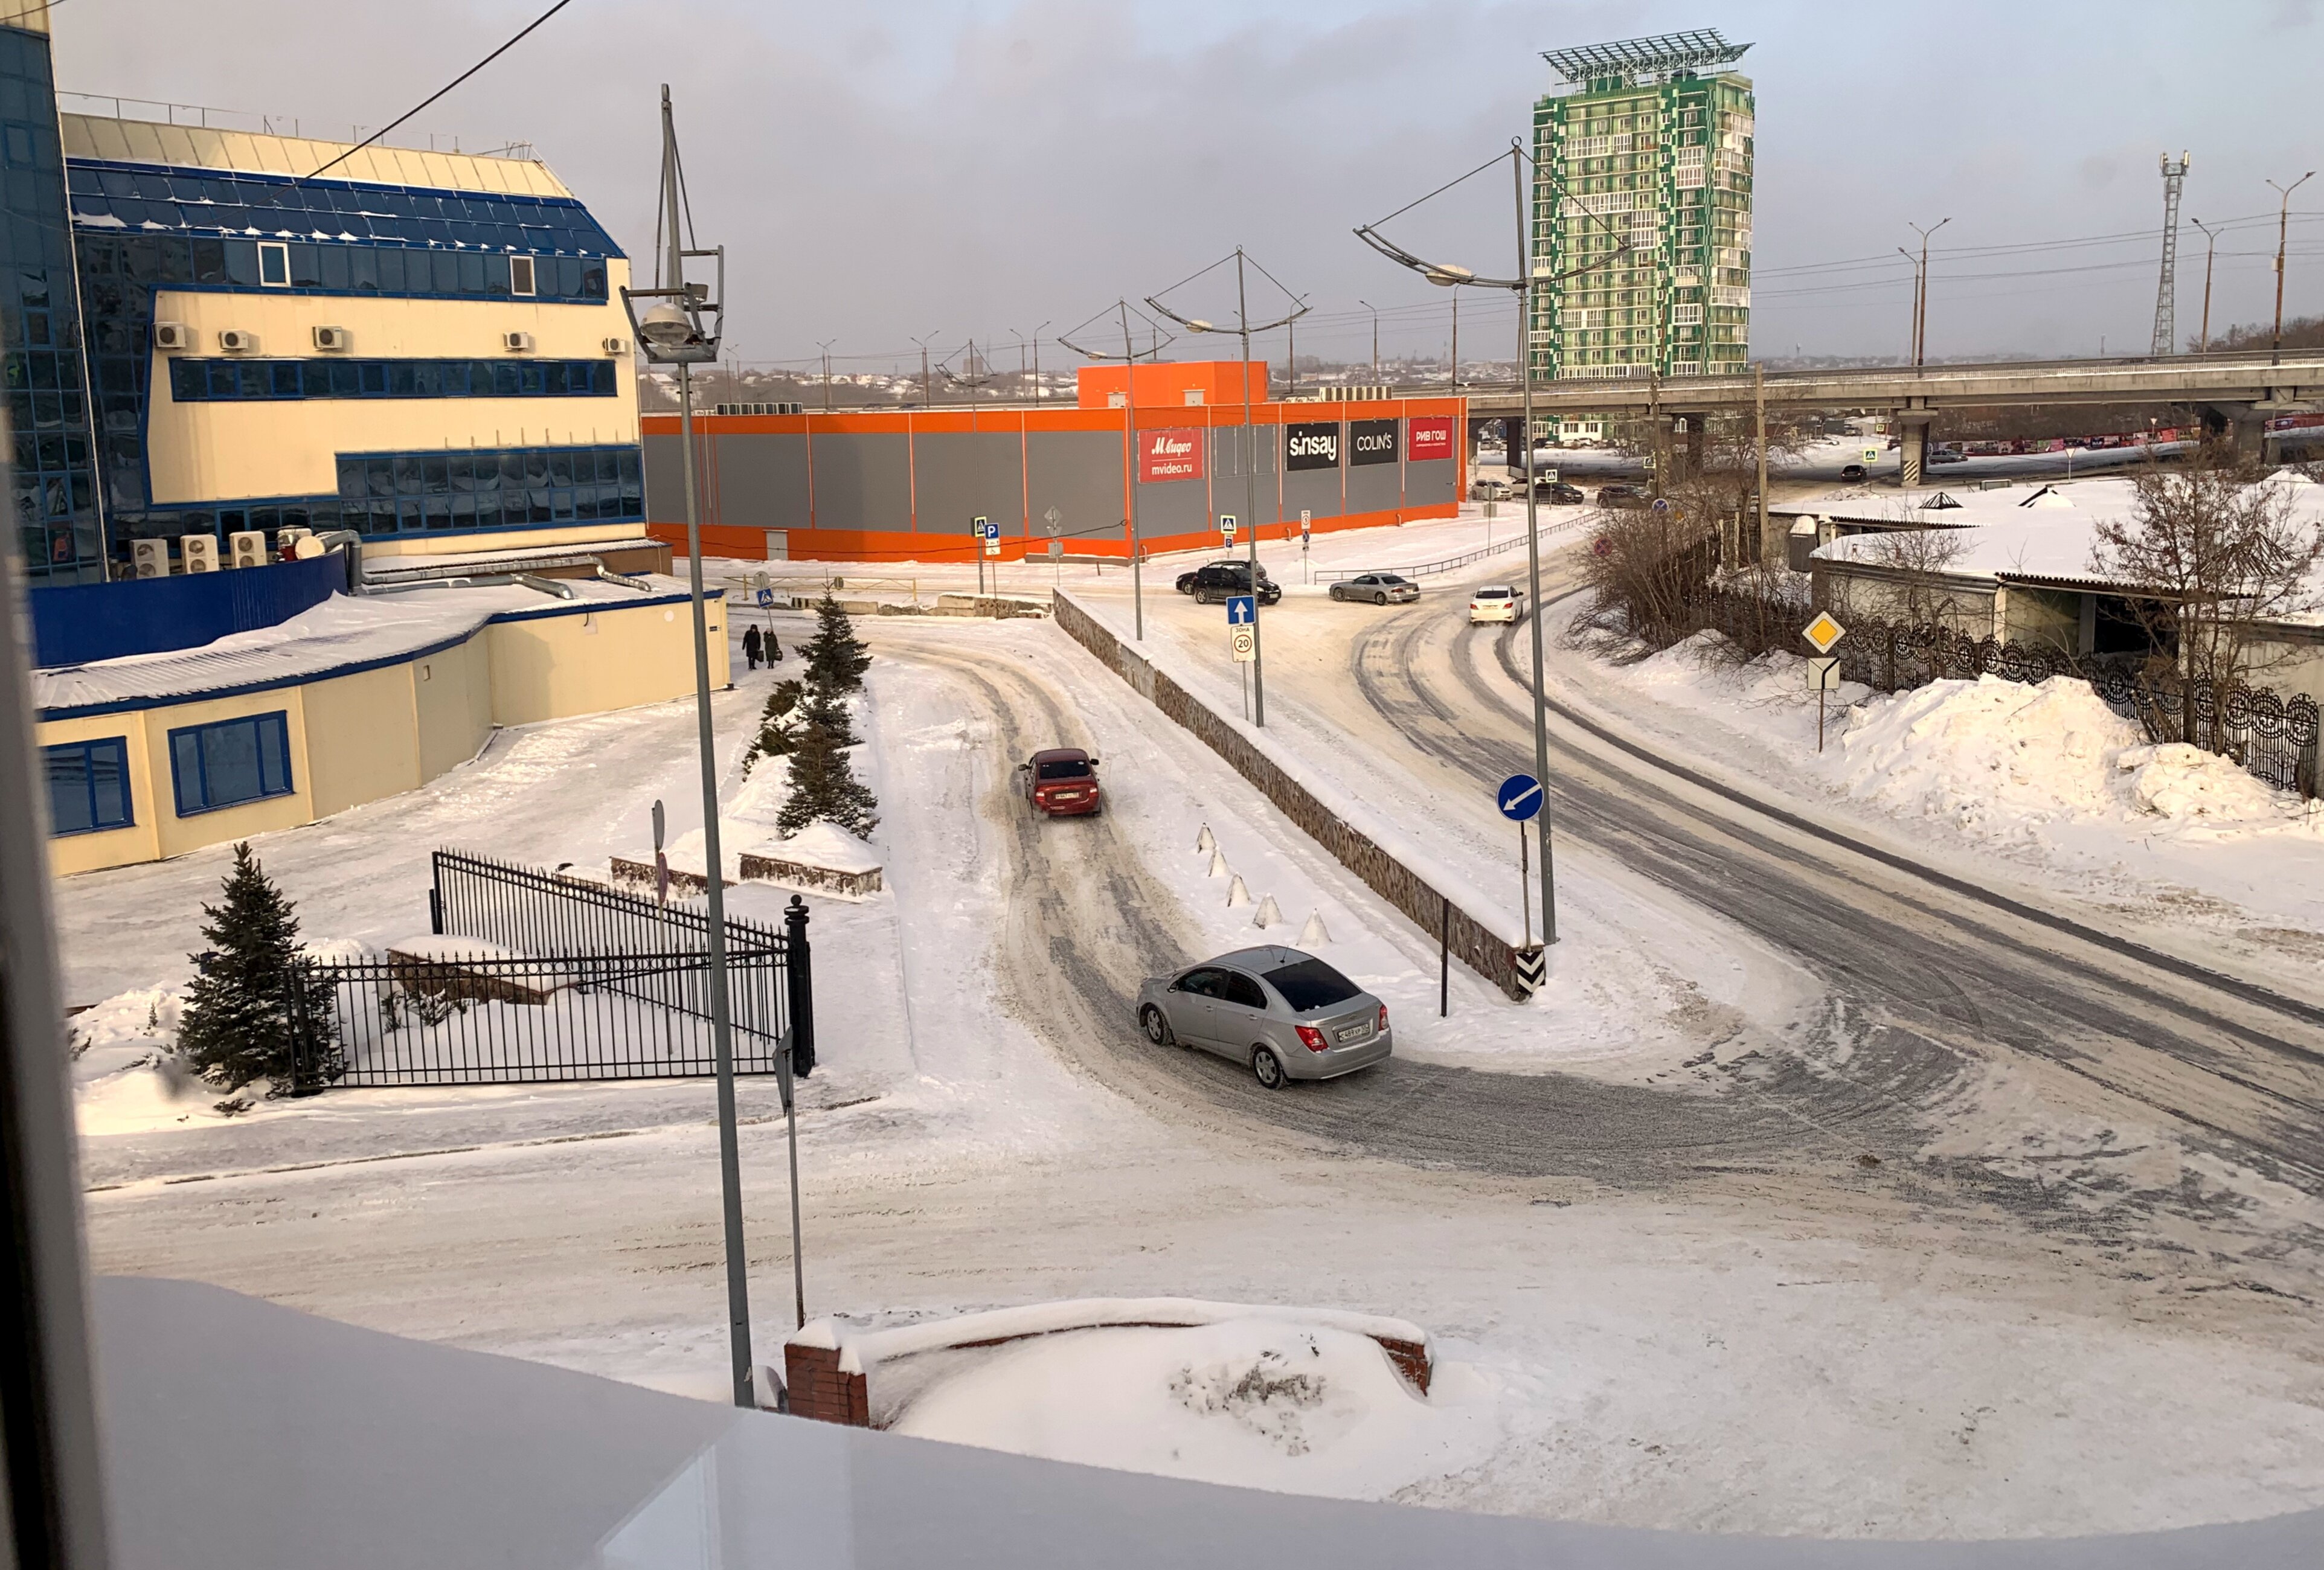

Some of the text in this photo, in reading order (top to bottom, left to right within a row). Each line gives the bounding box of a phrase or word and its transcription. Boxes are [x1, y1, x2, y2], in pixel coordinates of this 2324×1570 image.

[1357, 432, 1392, 451] COLIN'S
[1416, 429, 1446, 442] РИВ ГОШ
[1151, 437, 1192, 457] М.видео
[1289, 431, 1337, 461] sinsay
[1151, 462, 1192, 475] mvideo.ru
[987, 525, 996, 537] P
[1238, 639, 1249, 648] 20
